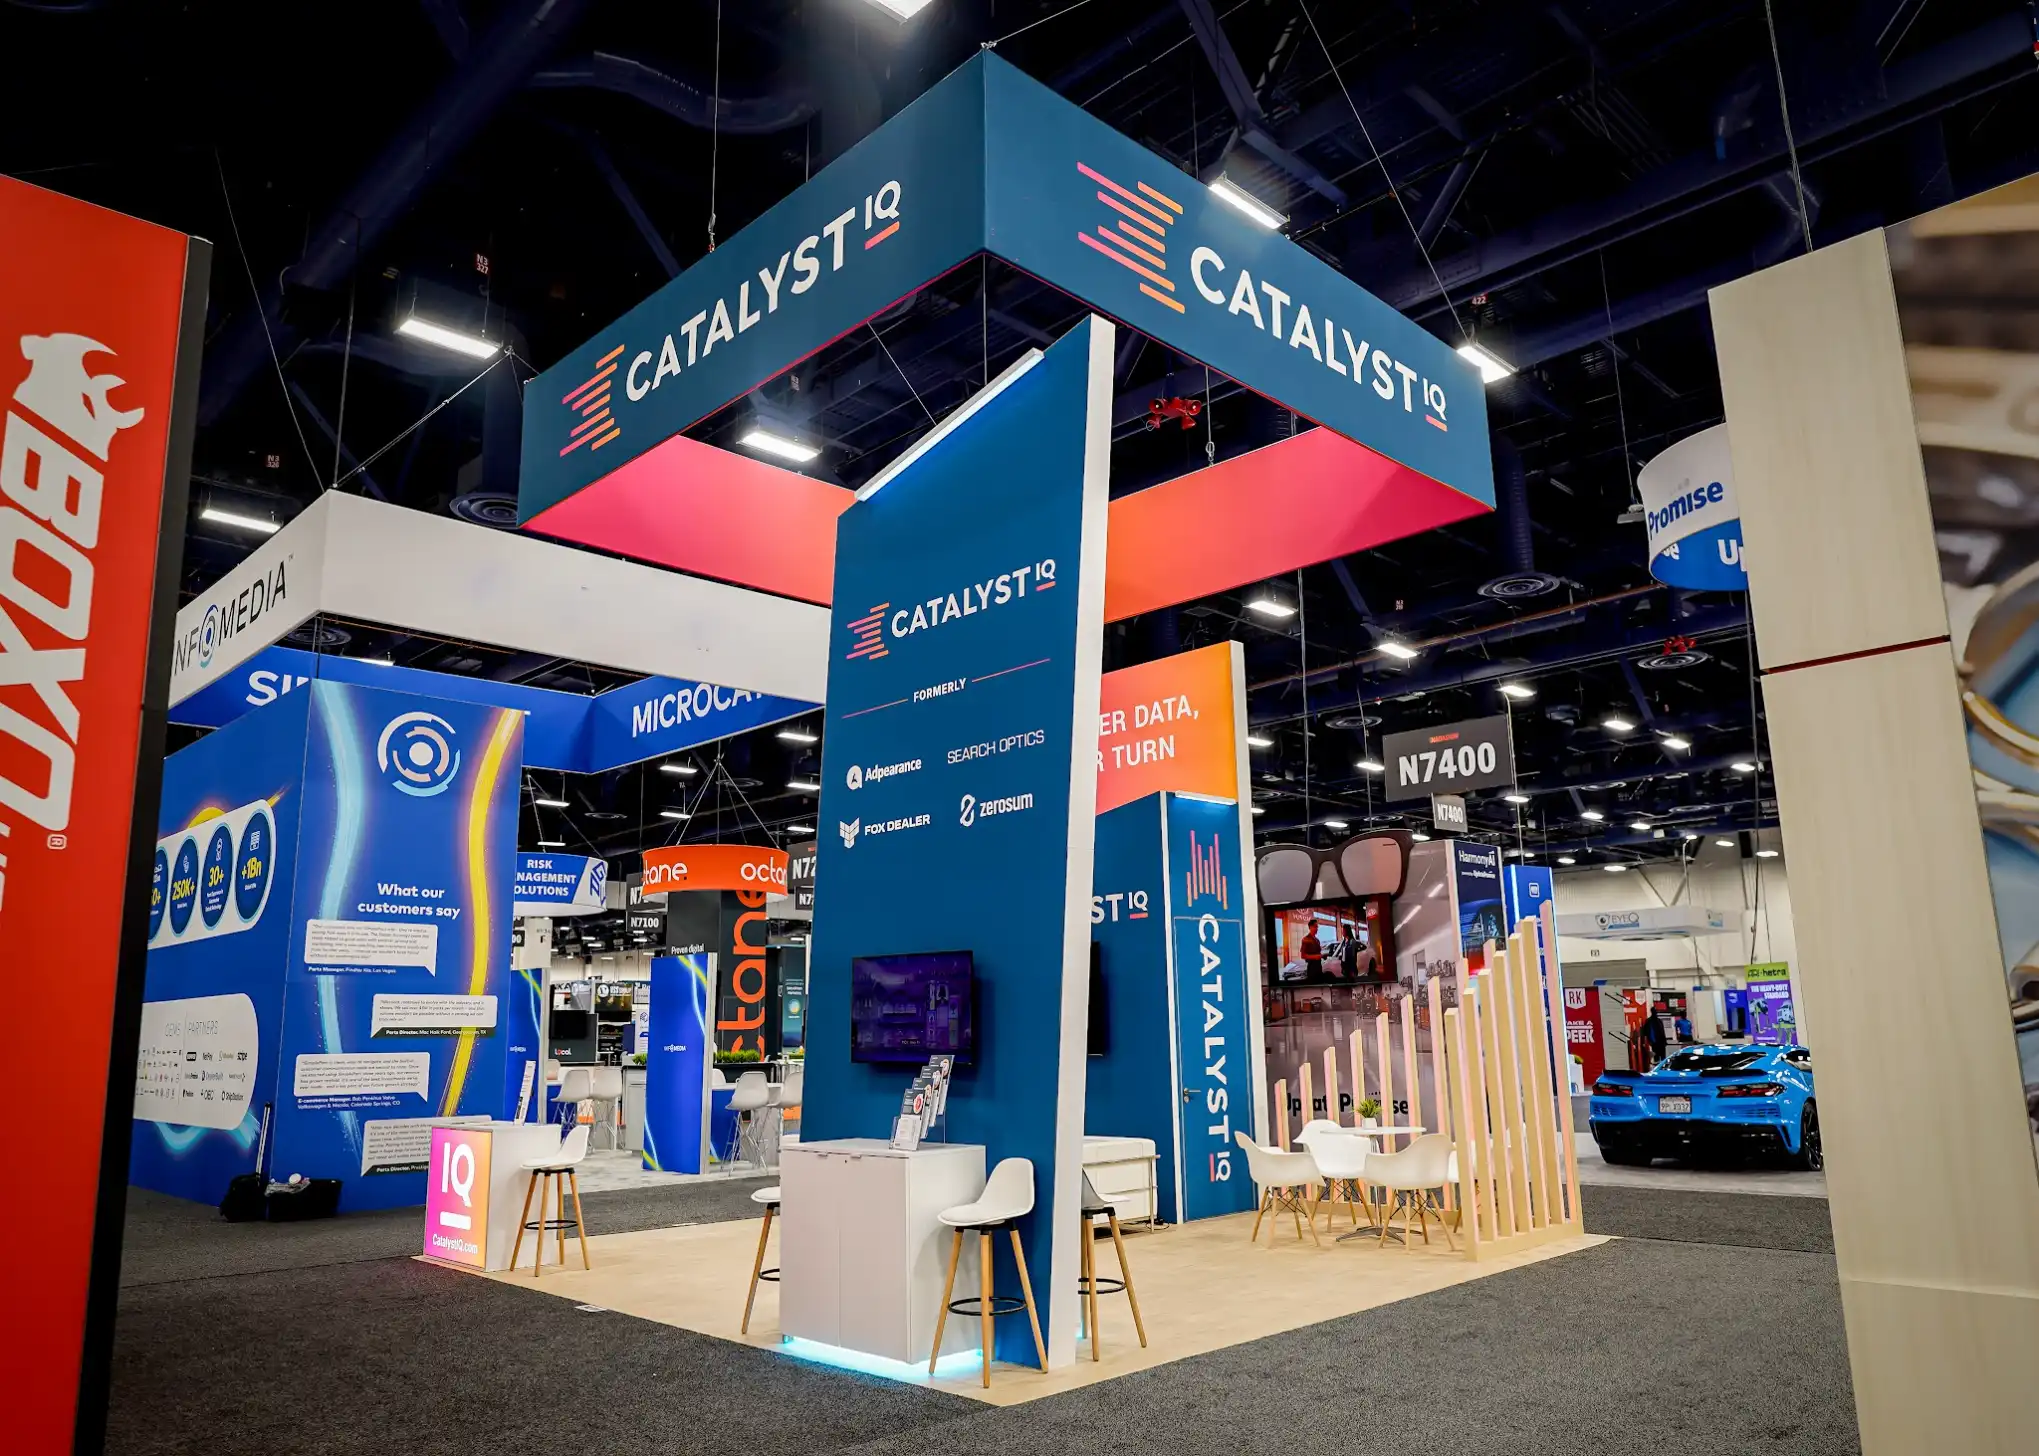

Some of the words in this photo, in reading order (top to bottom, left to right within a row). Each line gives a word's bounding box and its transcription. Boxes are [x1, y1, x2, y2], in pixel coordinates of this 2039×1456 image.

[626, 207, 856, 401] CATALYST
[864, 180, 901, 231] IQ
[1190, 246, 1417, 413] CATALYST
[1423, 378, 1448, 422] IQ
[1649, 481, 1723, 541] Promise
[891, 565, 1031, 639] CATALYST
[1035, 558, 1056, 581] IQ
[913, 677, 967, 703] FORMERLY
[1135, 694, 1199, 727] DATA,
[947, 741, 996, 764] SEARCH
[999, 729, 1045, 752] OPTICS
[1111, 734, 1176, 769] TURN
[865, 758, 922, 782] Adpearance
[1399, 742, 1496, 786] N7400
[979, 793, 1033, 818] zerosum
[1437, 803, 1463, 824] N7400
[864, 820, 886, 837] FOX
[887, 813, 931, 833] DEALER
[527, 859, 552, 869] RISK
[208, 865, 224, 888] 30+
[377, 883, 419, 898] What
[421, 887, 445, 899] our
[1128, 890, 1149, 911] IQ
[357, 901, 433, 916] customers
[435, 906, 461, 920] say
[630, 917, 659, 928] N7100
[671, 946, 688, 955] Proven
[1569, 991, 1582, 1004] RK
[1199, 913, 1230, 1143] CATALYST
[1215, 1151, 1231, 1182] IQ
[441, 1142, 475, 1207] IQ
[431, 1233, 478, 1255] CatalystIQ.com
